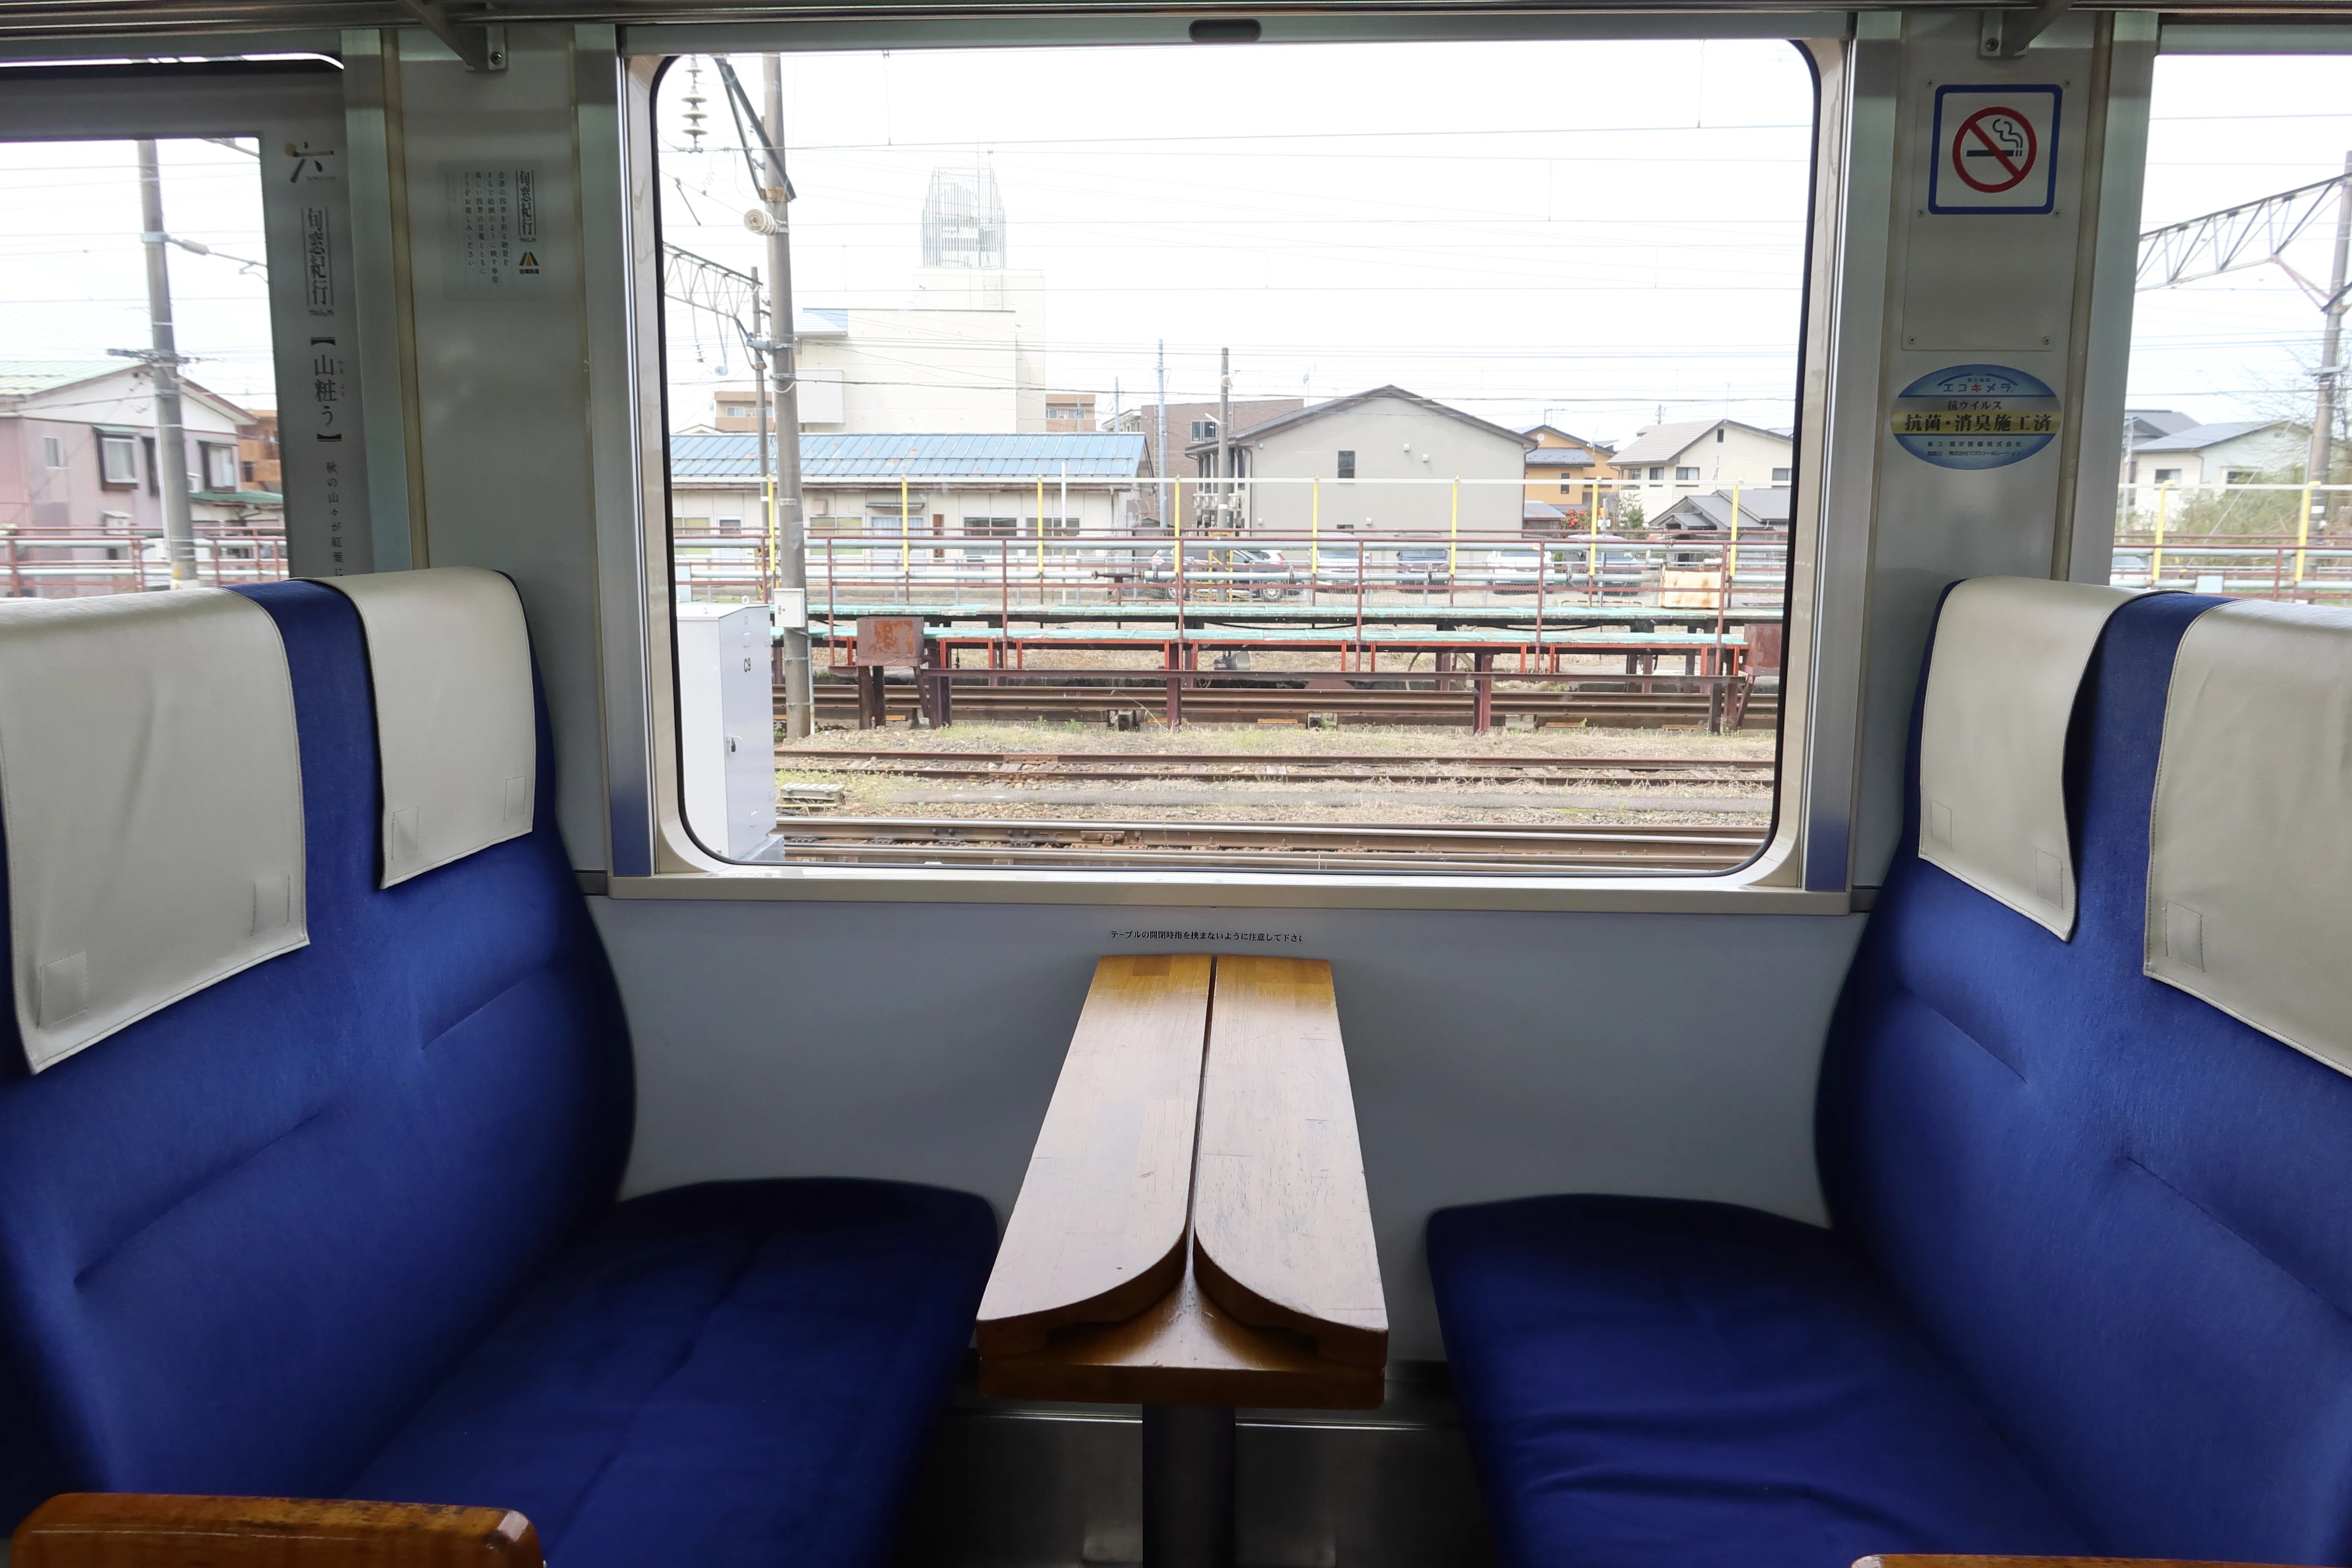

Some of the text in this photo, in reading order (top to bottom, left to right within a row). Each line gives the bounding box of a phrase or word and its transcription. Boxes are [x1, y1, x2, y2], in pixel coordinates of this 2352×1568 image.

[1943, 383, 2012, 393] エコキメラ
[1948, 400, 2002, 411] 抗ウイルス
[1905, 414, 2052, 432] 抗菌・消臭施工済
[744, 657, 751, 673] C9
